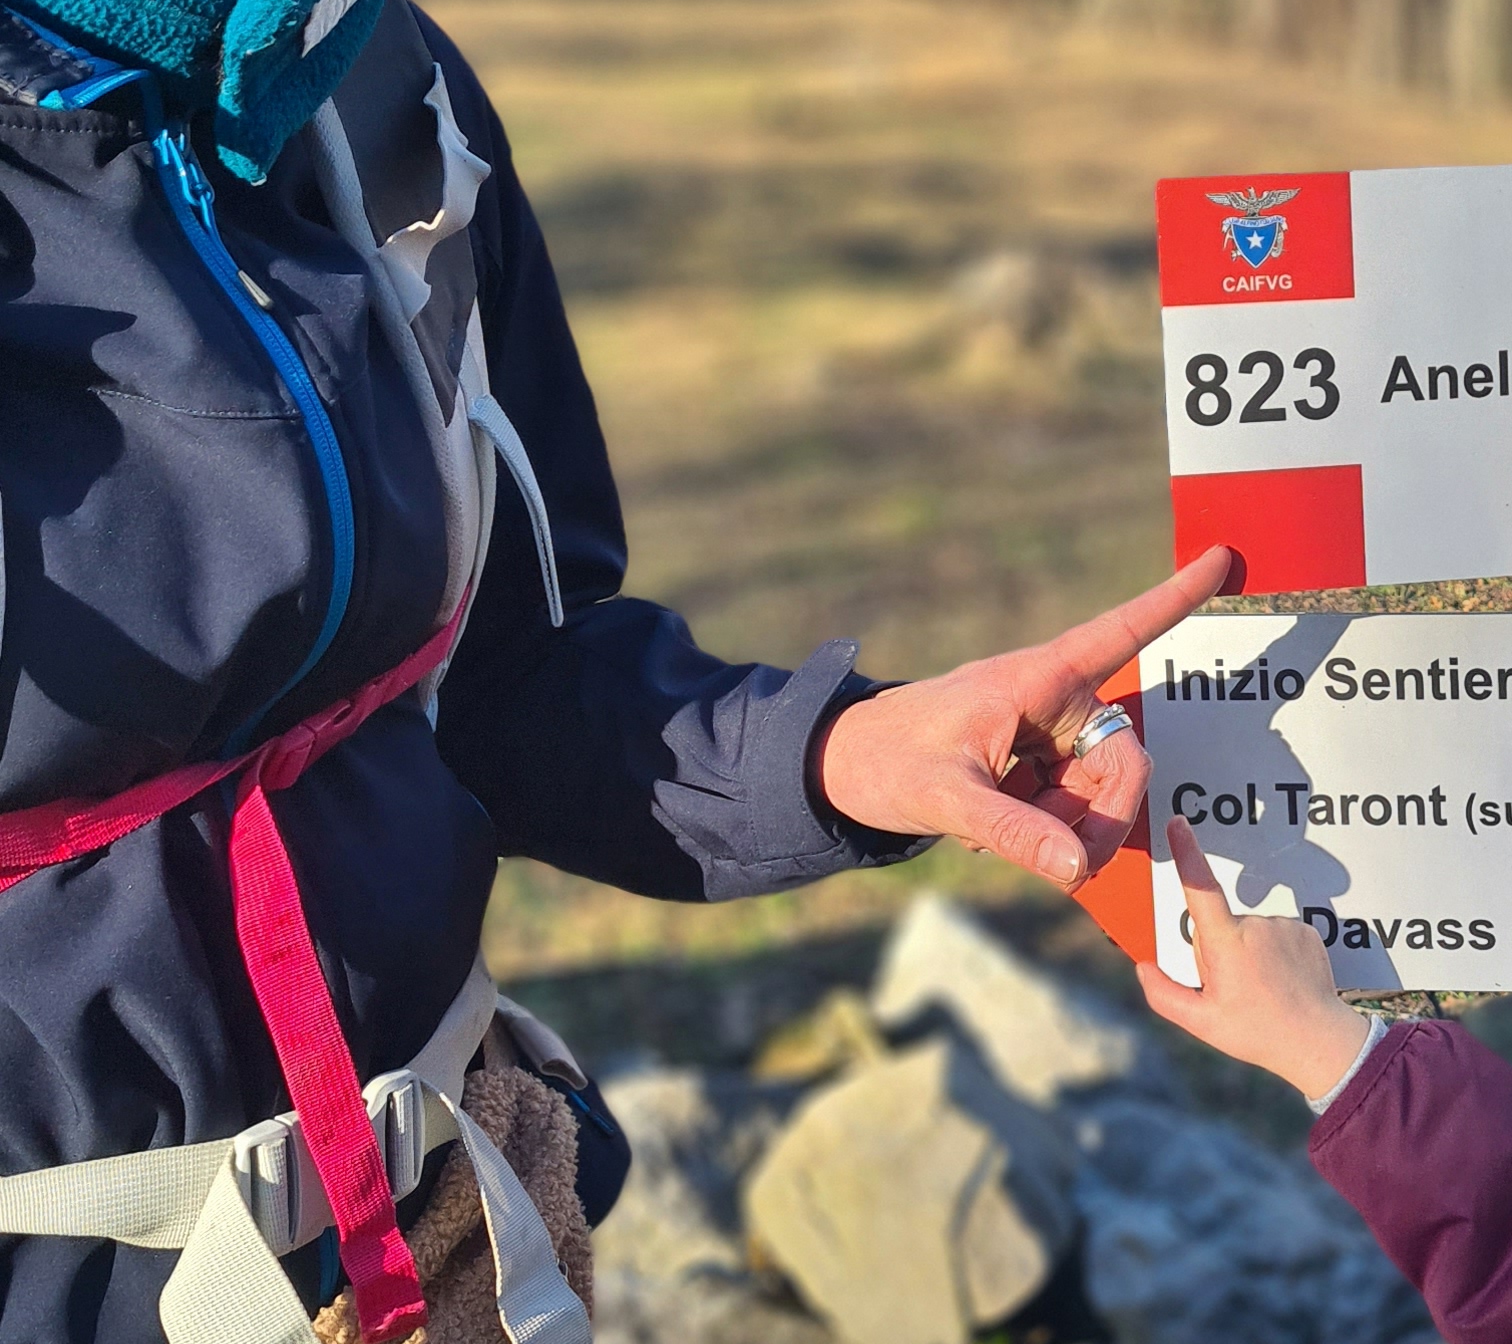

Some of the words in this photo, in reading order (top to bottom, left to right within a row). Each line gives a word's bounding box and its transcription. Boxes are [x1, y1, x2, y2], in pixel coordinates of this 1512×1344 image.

[1222, 274, 1293, 293] CAIFVG
[1184, 347, 1341, 427] 823
[1165, 658, 1304, 701] Inizio
[1171, 781, 1258, 826] Col
[1274, 782, 1448, 826] Taront
[1303, 906, 1497, 951] Davass
